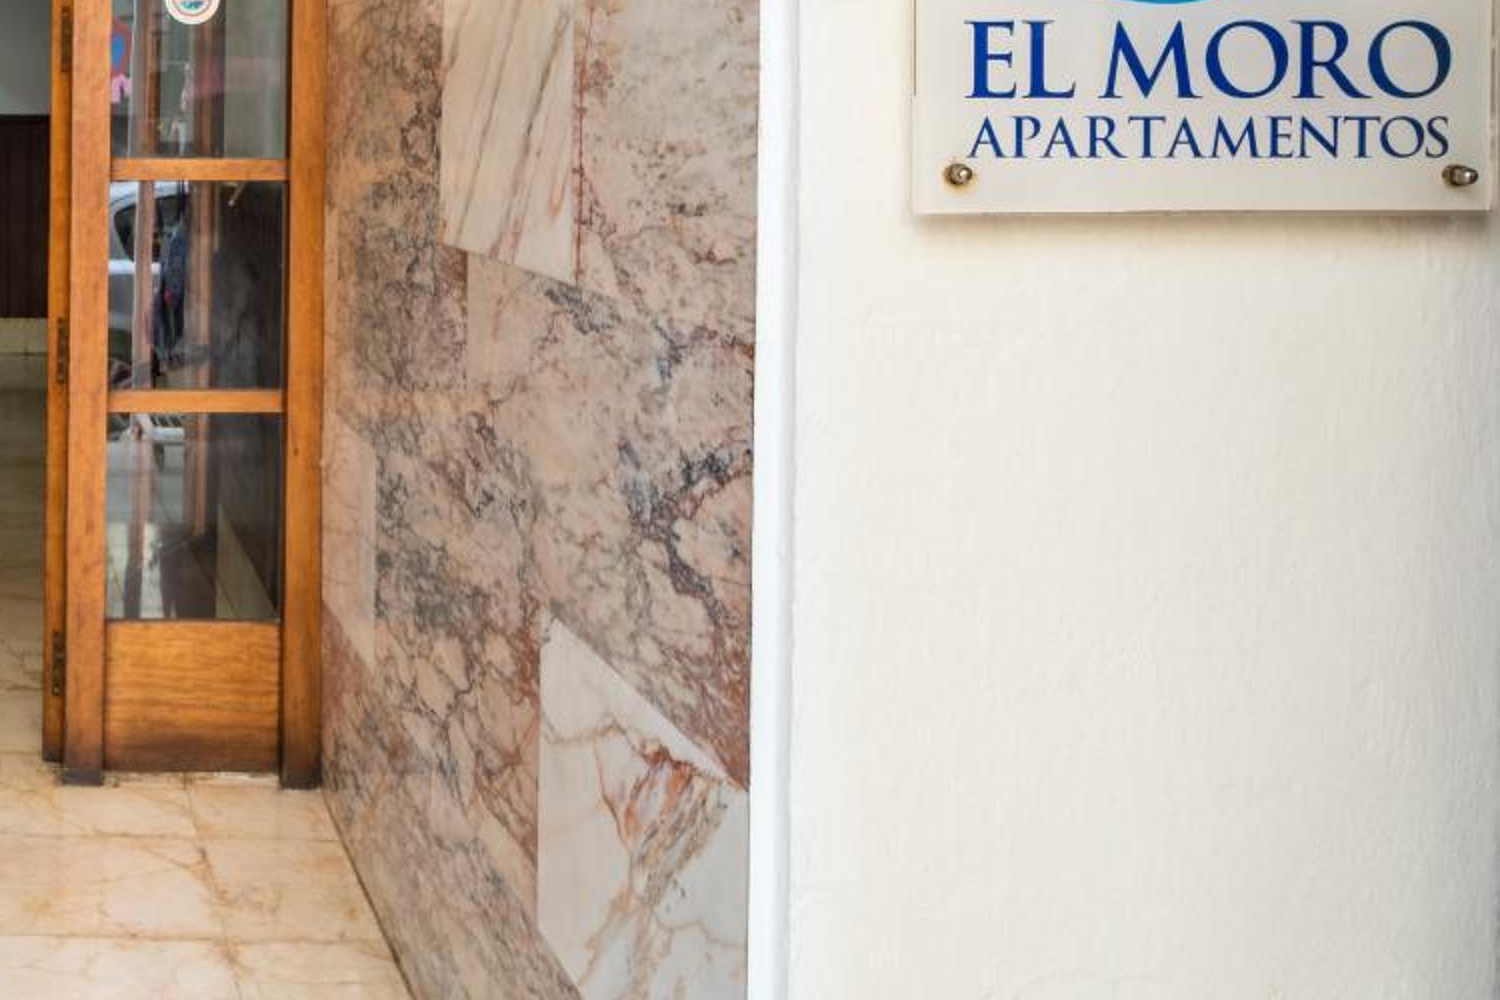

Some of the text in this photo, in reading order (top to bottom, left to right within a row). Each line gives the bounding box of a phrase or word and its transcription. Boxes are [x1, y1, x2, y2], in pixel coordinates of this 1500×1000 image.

[964, 19, 1453, 100] EL MORO
[965, 114, 1450, 159] APARTAMENTOS
